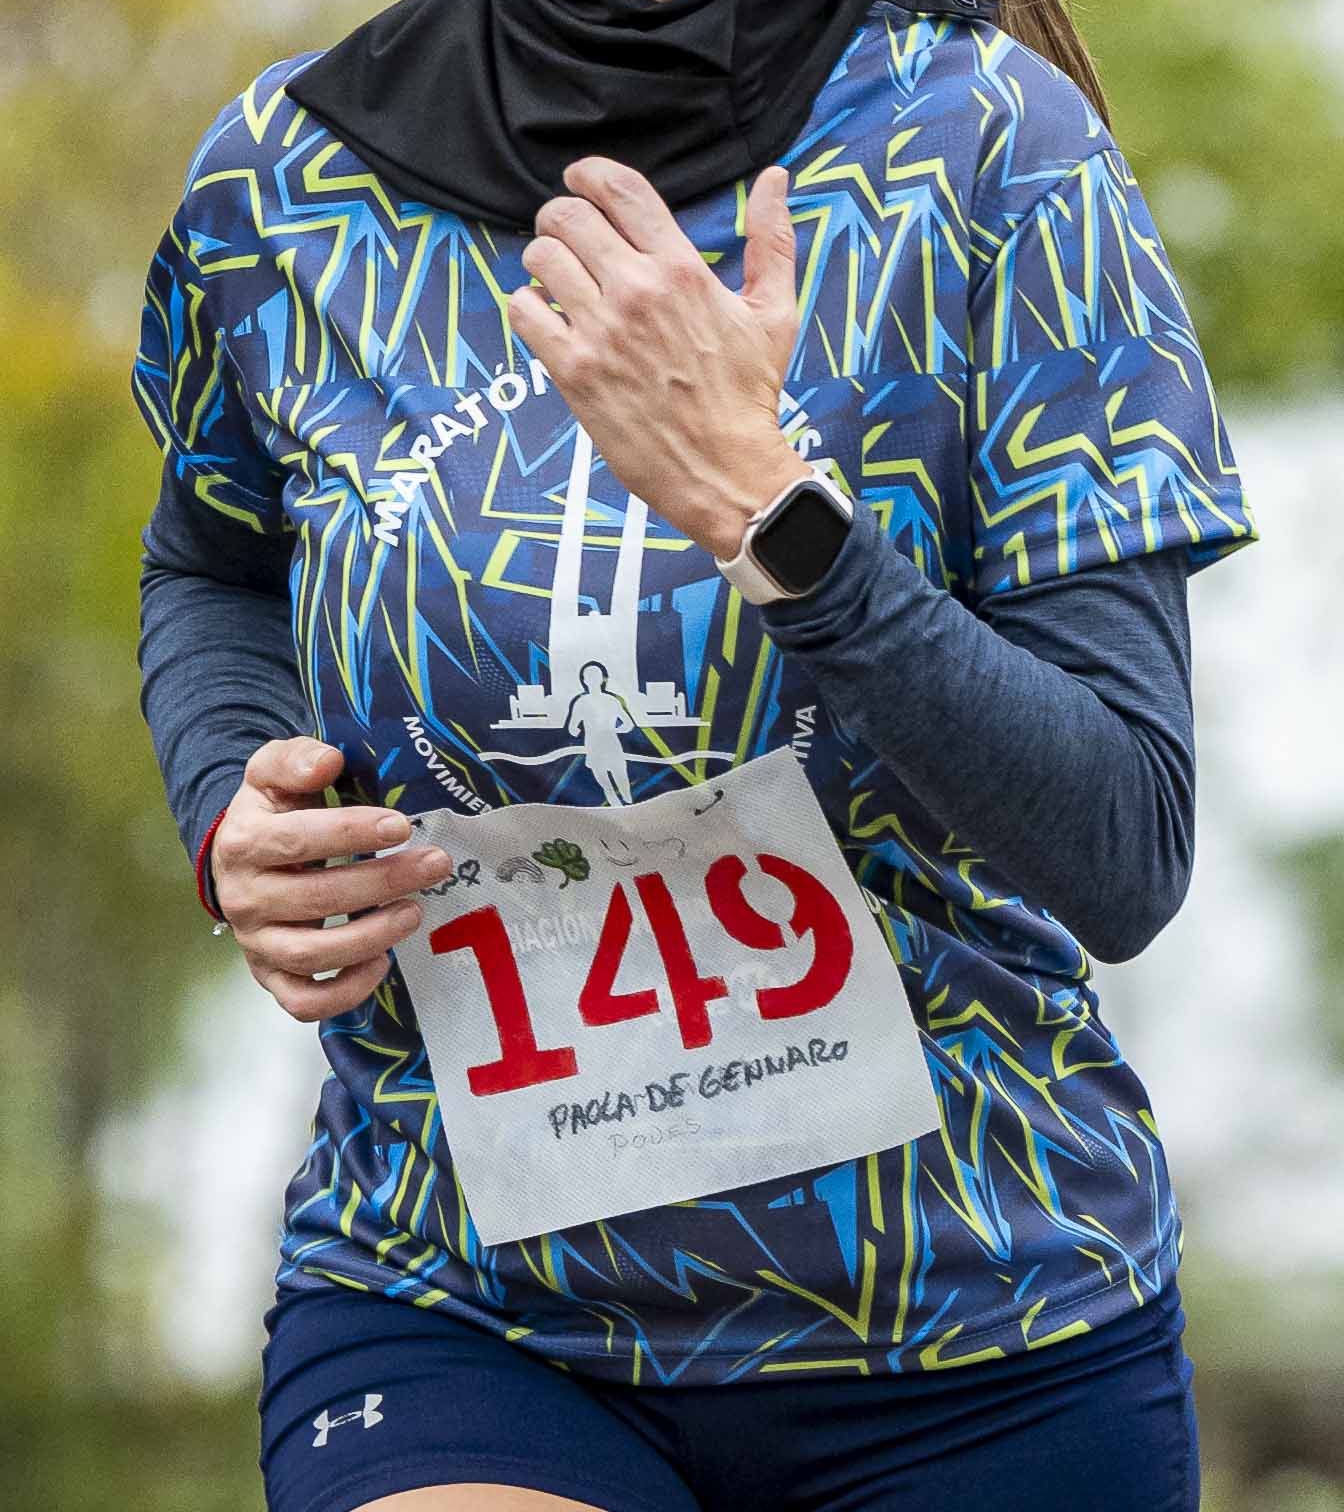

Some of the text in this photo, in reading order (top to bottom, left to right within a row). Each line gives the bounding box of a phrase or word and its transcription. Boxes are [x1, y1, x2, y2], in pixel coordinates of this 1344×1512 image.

[429, 853, 854, 1098] 149
[548, 1038, 849, 1140] PAOLA DE GENNARO
